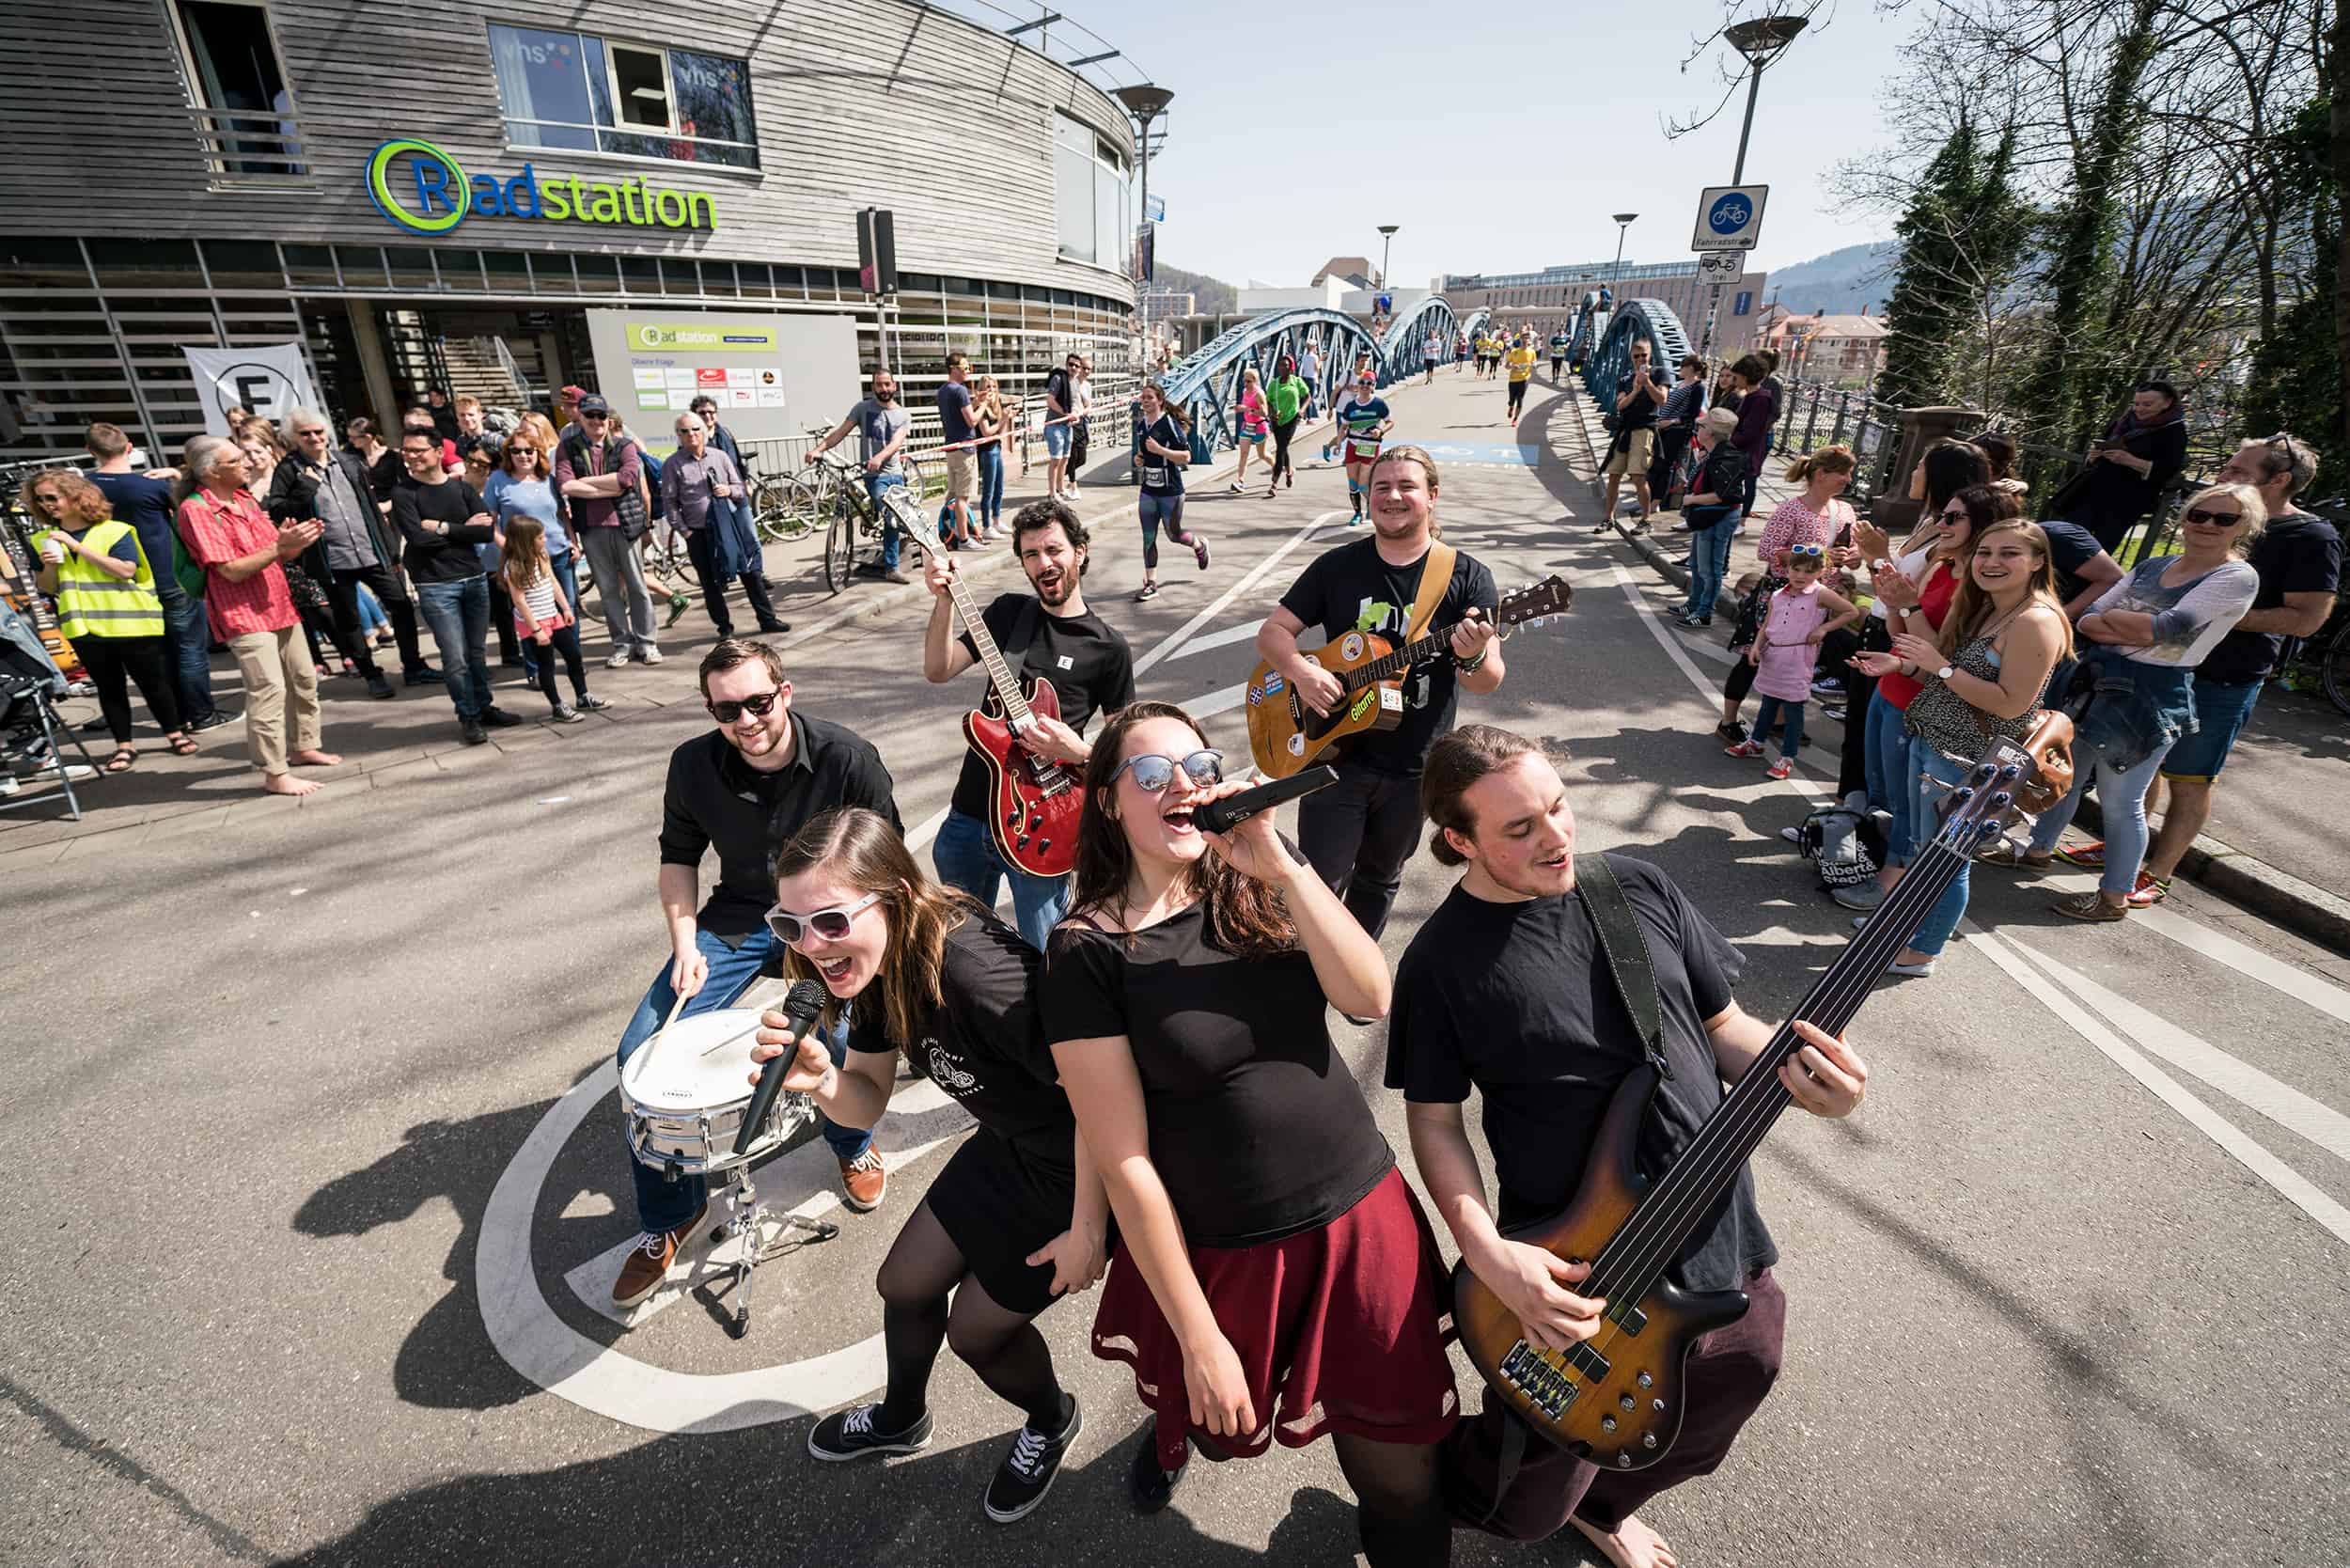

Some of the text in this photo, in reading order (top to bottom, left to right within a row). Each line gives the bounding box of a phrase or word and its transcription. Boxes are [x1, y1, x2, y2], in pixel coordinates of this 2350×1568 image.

[681, 65, 718, 87] vhs
[411, 157, 719, 230] Radstation
[1697, 238, 1753, 246] Fahrradstr
[649, 330, 717, 345] Radstation
[1351, 689, 1375, 722] Gitarre
